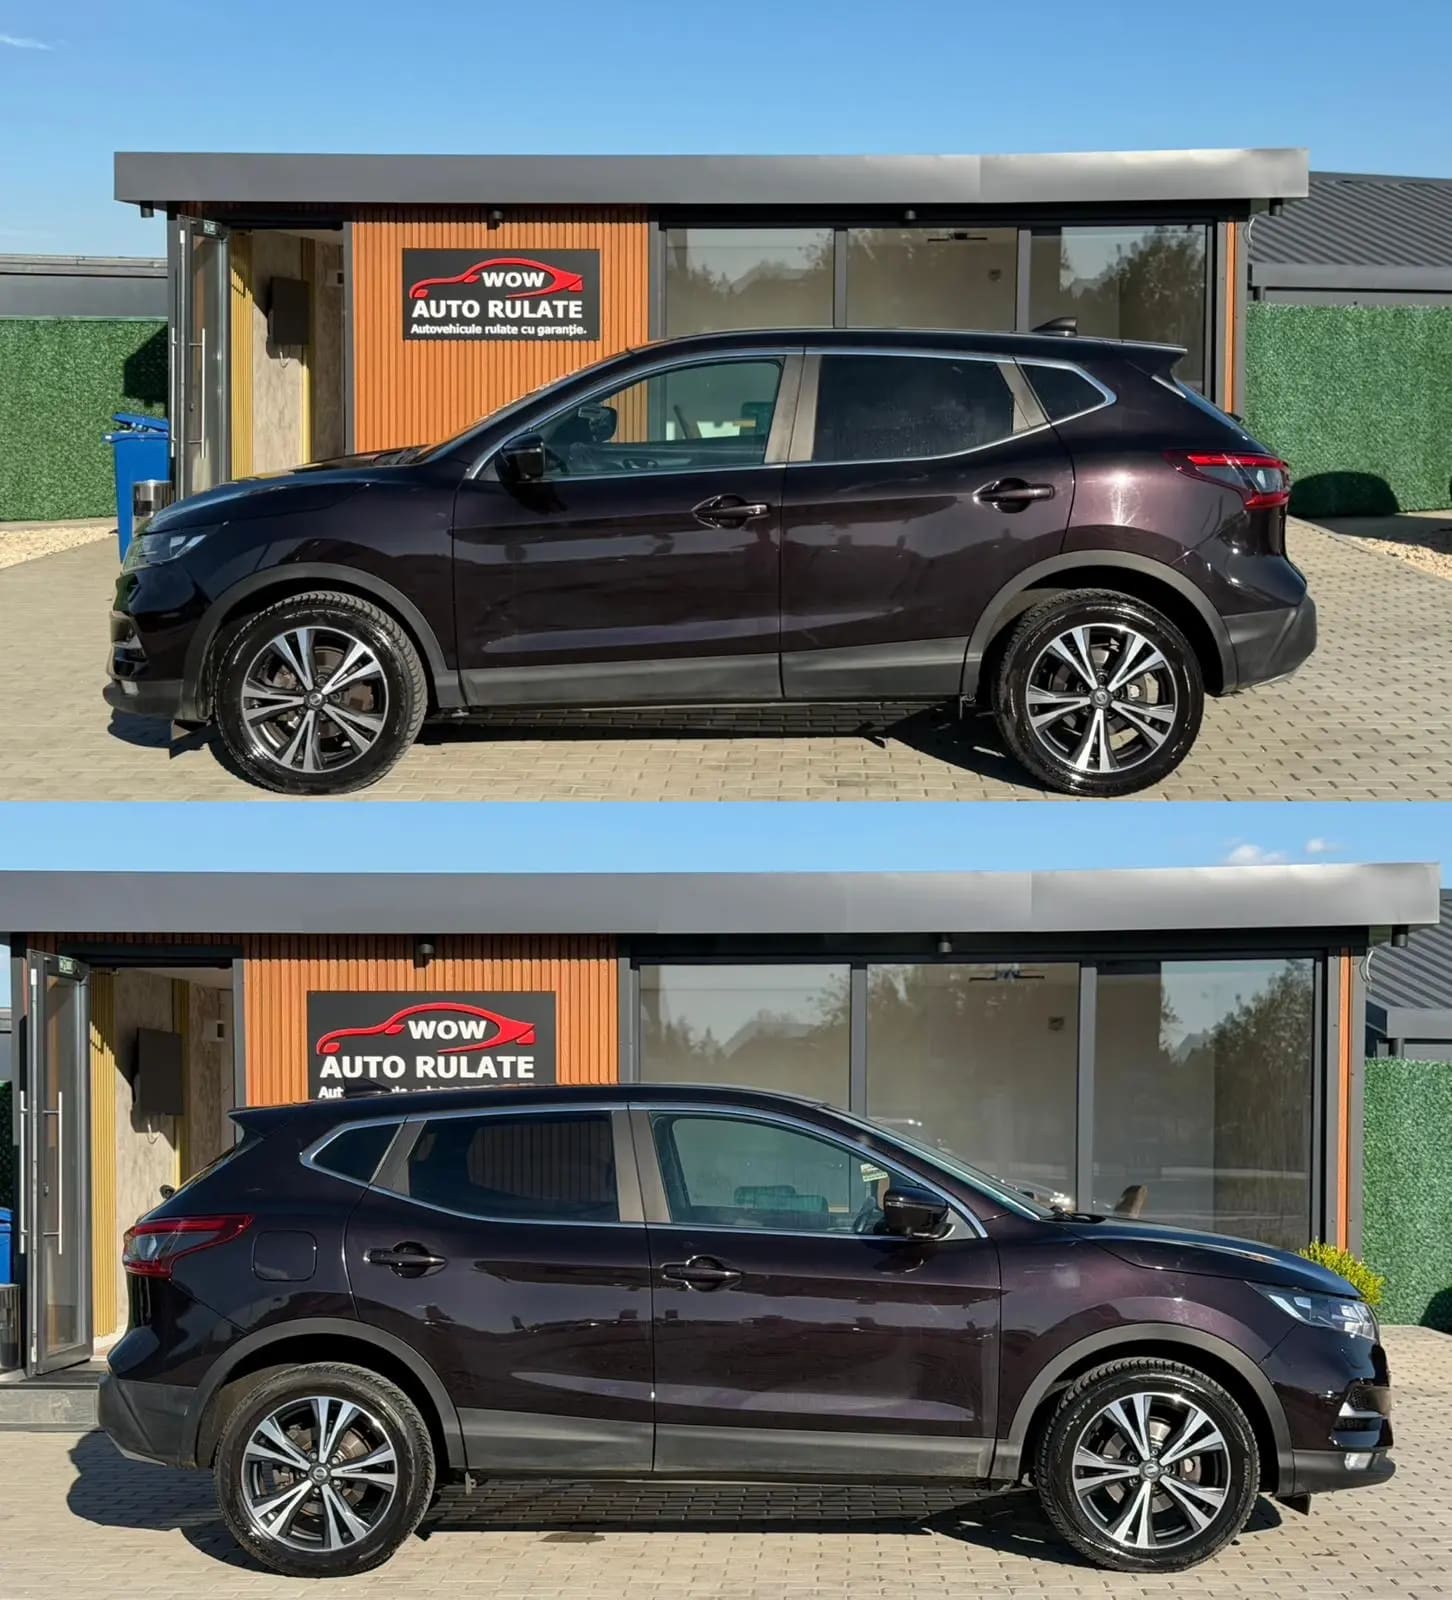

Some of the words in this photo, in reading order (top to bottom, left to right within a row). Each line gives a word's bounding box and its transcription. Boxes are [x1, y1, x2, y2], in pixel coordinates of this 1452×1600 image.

[482, 272, 545, 287] WOW
[411, 300, 480, 318] AUTO
[488, 300, 583, 318] RULATE
[410, 323, 482, 335] Autovehicule
[484, 323, 518, 335] rulate
[521, 325, 535, 335] cu
[408, 1020, 487, 1040] WOW
[319, 1056, 406, 1078] AUTO
[416, 1056, 535, 1078] RULATE
